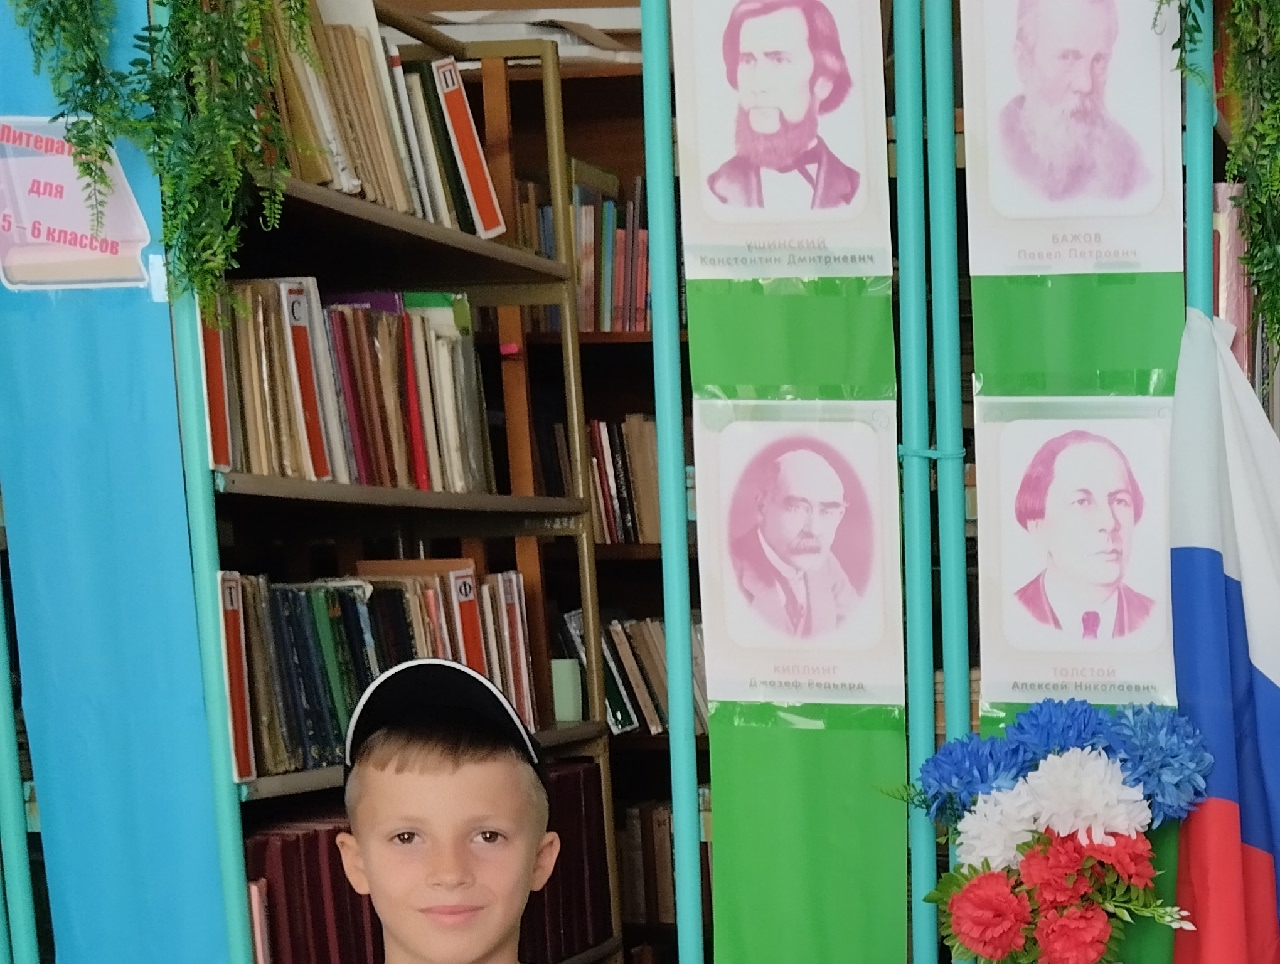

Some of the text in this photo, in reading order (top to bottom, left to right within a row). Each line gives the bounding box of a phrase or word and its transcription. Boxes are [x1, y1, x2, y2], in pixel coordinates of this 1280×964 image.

[28, 179, 64, 199] для
[1, 214, 12, 232] 5
[31, 220, 41, 239] 6
[46, 226, 120, 255] классов
[1052, 233, 1102, 244] БАЖОВ
[745, 238, 827, 251] УШИНСКИЙ
[700, 253, 874, 266] Константин Дмитриевич
[1017, 248, 1137, 260] Павел Петрович
[774, 665, 836, 675] КИПЛИНГ
[1052, 667, 1116, 678] ТОЛСТОЙ
[749, 679, 800, 690] Джозеф
[1011, 681, 1157, 692] Алексей Николаевич
